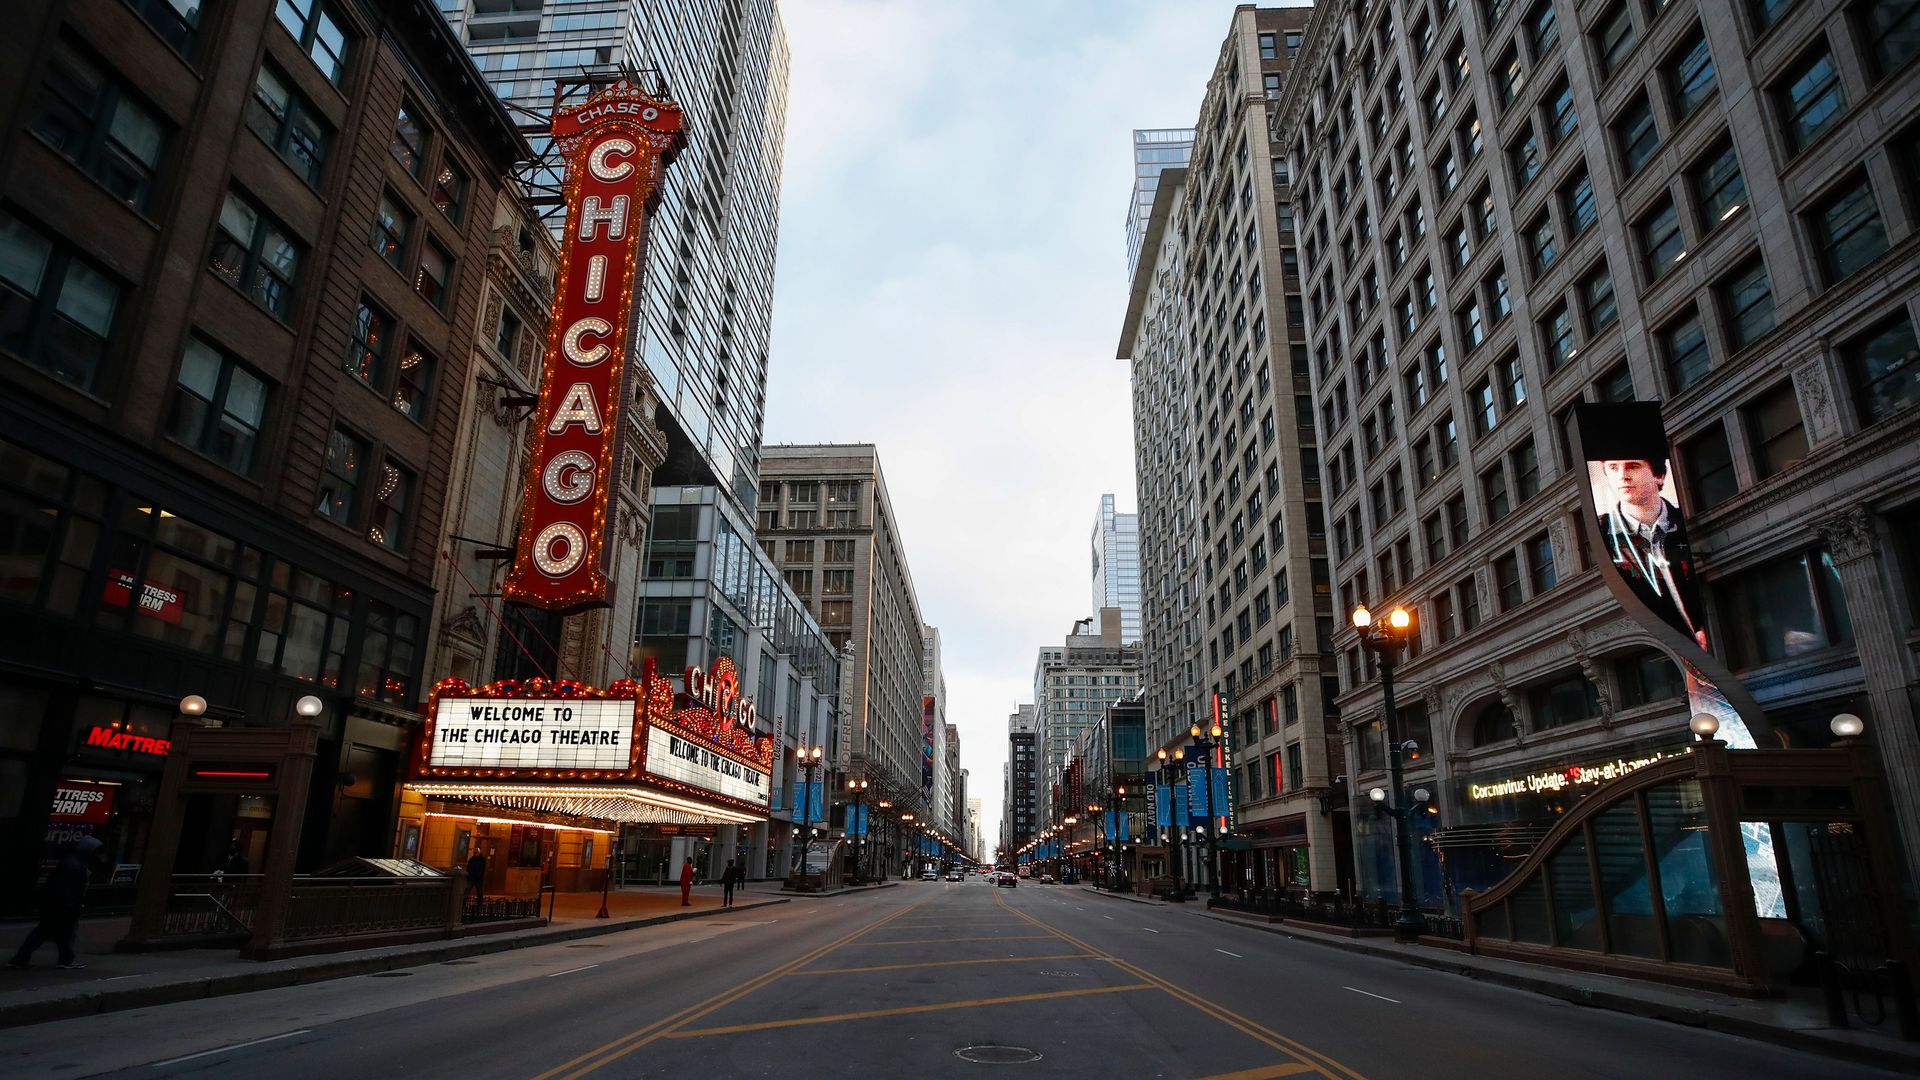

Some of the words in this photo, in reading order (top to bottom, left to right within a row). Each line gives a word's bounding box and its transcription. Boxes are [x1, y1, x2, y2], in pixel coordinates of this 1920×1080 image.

[577, 102, 641, 124] CHASE
[532, 138, 637, 580] CHICAGO
[691, 666, 756, 729] CHICGO
[844, 655, 855, 705] BALLET
[471, 706, 545, 722] WELCOME
[553, 707, 573, 722] TO
[1220, 697, 1229, 727] GENE
[440, 728, 469, 743] THE
[474, 728, 542, 744] CHICAGO
[550, 730, 620, 745] THEATRE
[773, 715, 784, 761] Walgreens
[841, 709, 852, 771] JOFFREY
[1223, 731, 1232, 776] SISKEL
[669, 736, 699, 764] WELCOME
[701, 749, 709, 767] TO
[710, 753, 720, 772] THE
[721, 758, 741, 780] CHICAGO
[743, 766, 761, 787] THEATRE
[1146, 783, 1156, 801] OLD
[1146, 802, 1156, 827] NAVY
